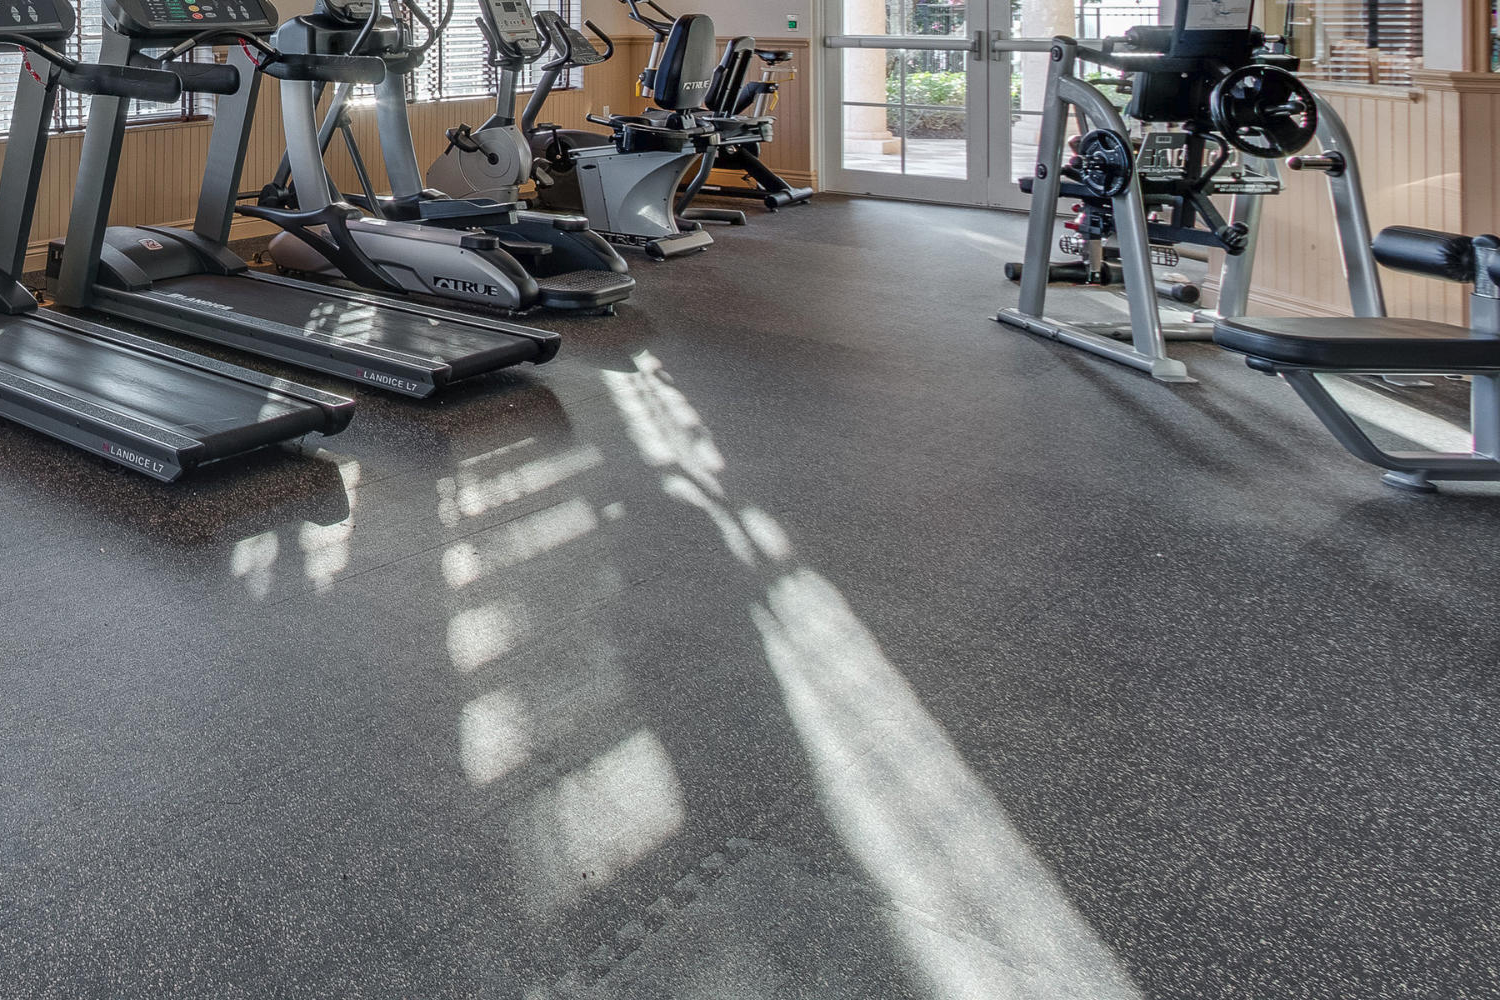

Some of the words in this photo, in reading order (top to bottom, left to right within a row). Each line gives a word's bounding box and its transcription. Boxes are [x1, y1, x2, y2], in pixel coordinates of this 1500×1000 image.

[691, 80, 710, 89] TRUE
[449, 279, 499, 297] TRUE
[363, 371, 404, 389] LANDICE
[406, 382, 418, 392] L7
[110, 445, 151, 469] LANDICE
[152, 462, 164, 473] L7
